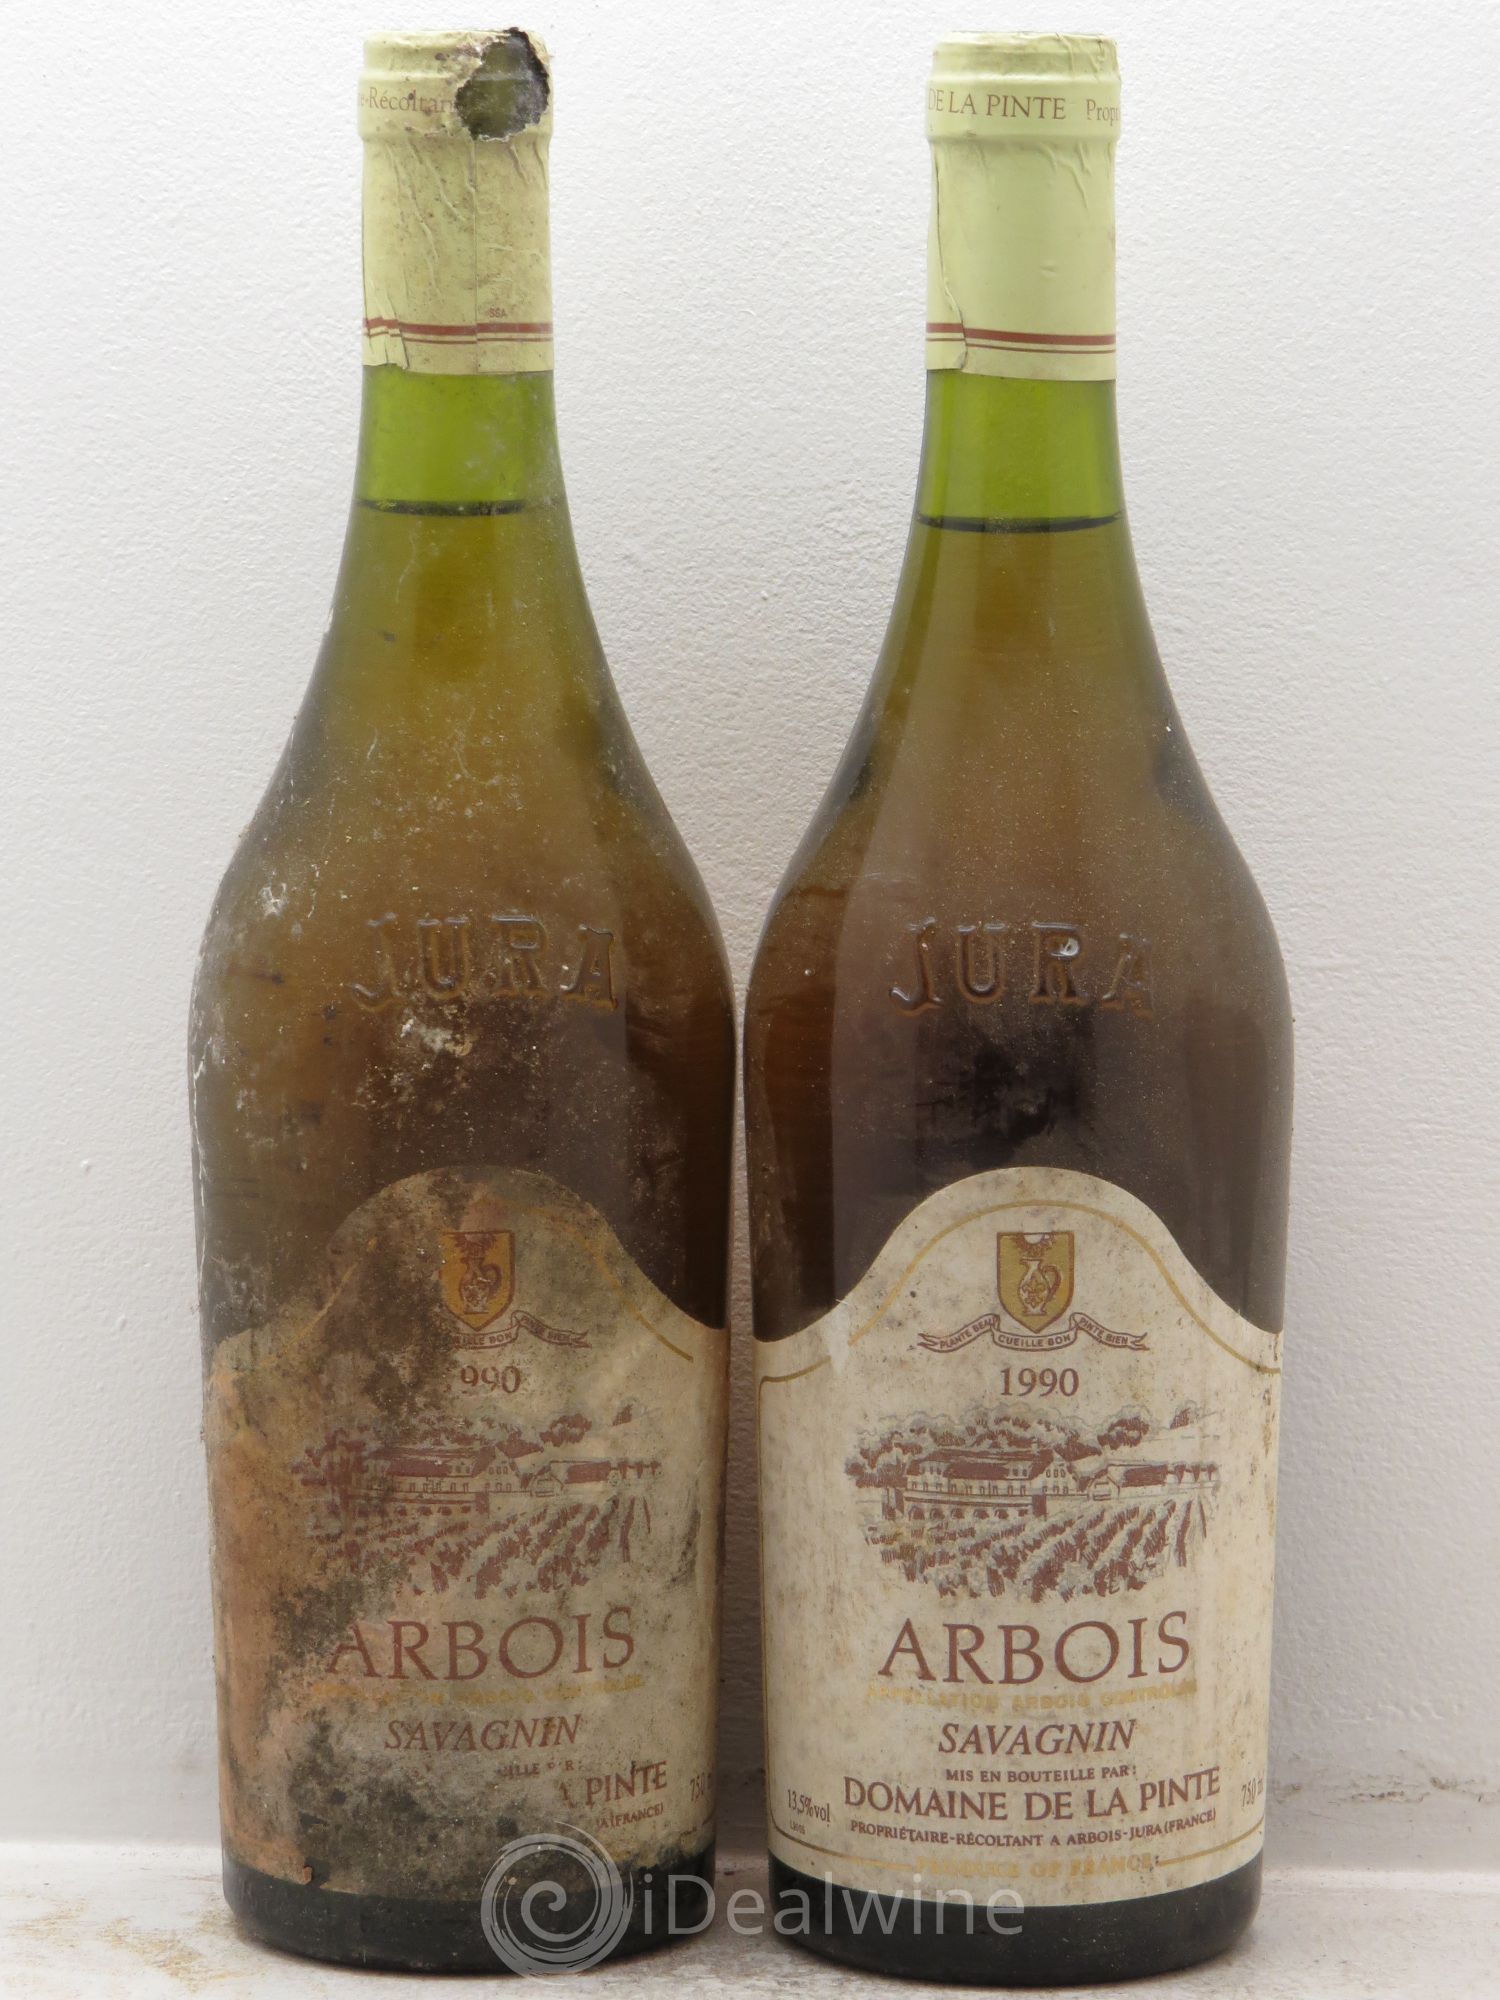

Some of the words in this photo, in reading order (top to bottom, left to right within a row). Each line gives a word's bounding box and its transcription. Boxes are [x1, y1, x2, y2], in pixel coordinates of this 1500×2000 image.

[949, 91, 977, 115] LA
[987, 94, 1066, 120] PINTE
[349, 912, 618, 1012] JURA
[889, 916, 1154, 1017] JURA
[940, 1330, 972, 1350] PLANTE
[999, 1335, 1044, 1348] CUEILLE
[1047, 1334, 1071, 1346] BON
[1105, 1333, 1129, 1345] BIEN
[460, 1365, 522, 1394] 990
[1000, 1367, 1080, 1397] 1990
[325, 1606, 635, 1681] ARBOIS
[878, 1610, 1190, 1685] ARBOIS
[384, 1713, 582, 1752] SAVAGNIN
[938, 1718, 1137, 1756] SAVAGNIN
[585, 1761, 668, 1808] PINTE
[946, 1769, 974, 1782] MIS
[980, 1770, 1001, 1783] EN
[1008, 1767, 1096, 1783] BOUTEILLE
[844, 1776, 1009, 1821] DOMAINE
[1024, 1791, 1073, 1821] DE
[1087, 1787, 1130, 1818] LA
[1139, 1765, 1221, 1812] PINTE
[1050, 1835, 1061, 1846] A
